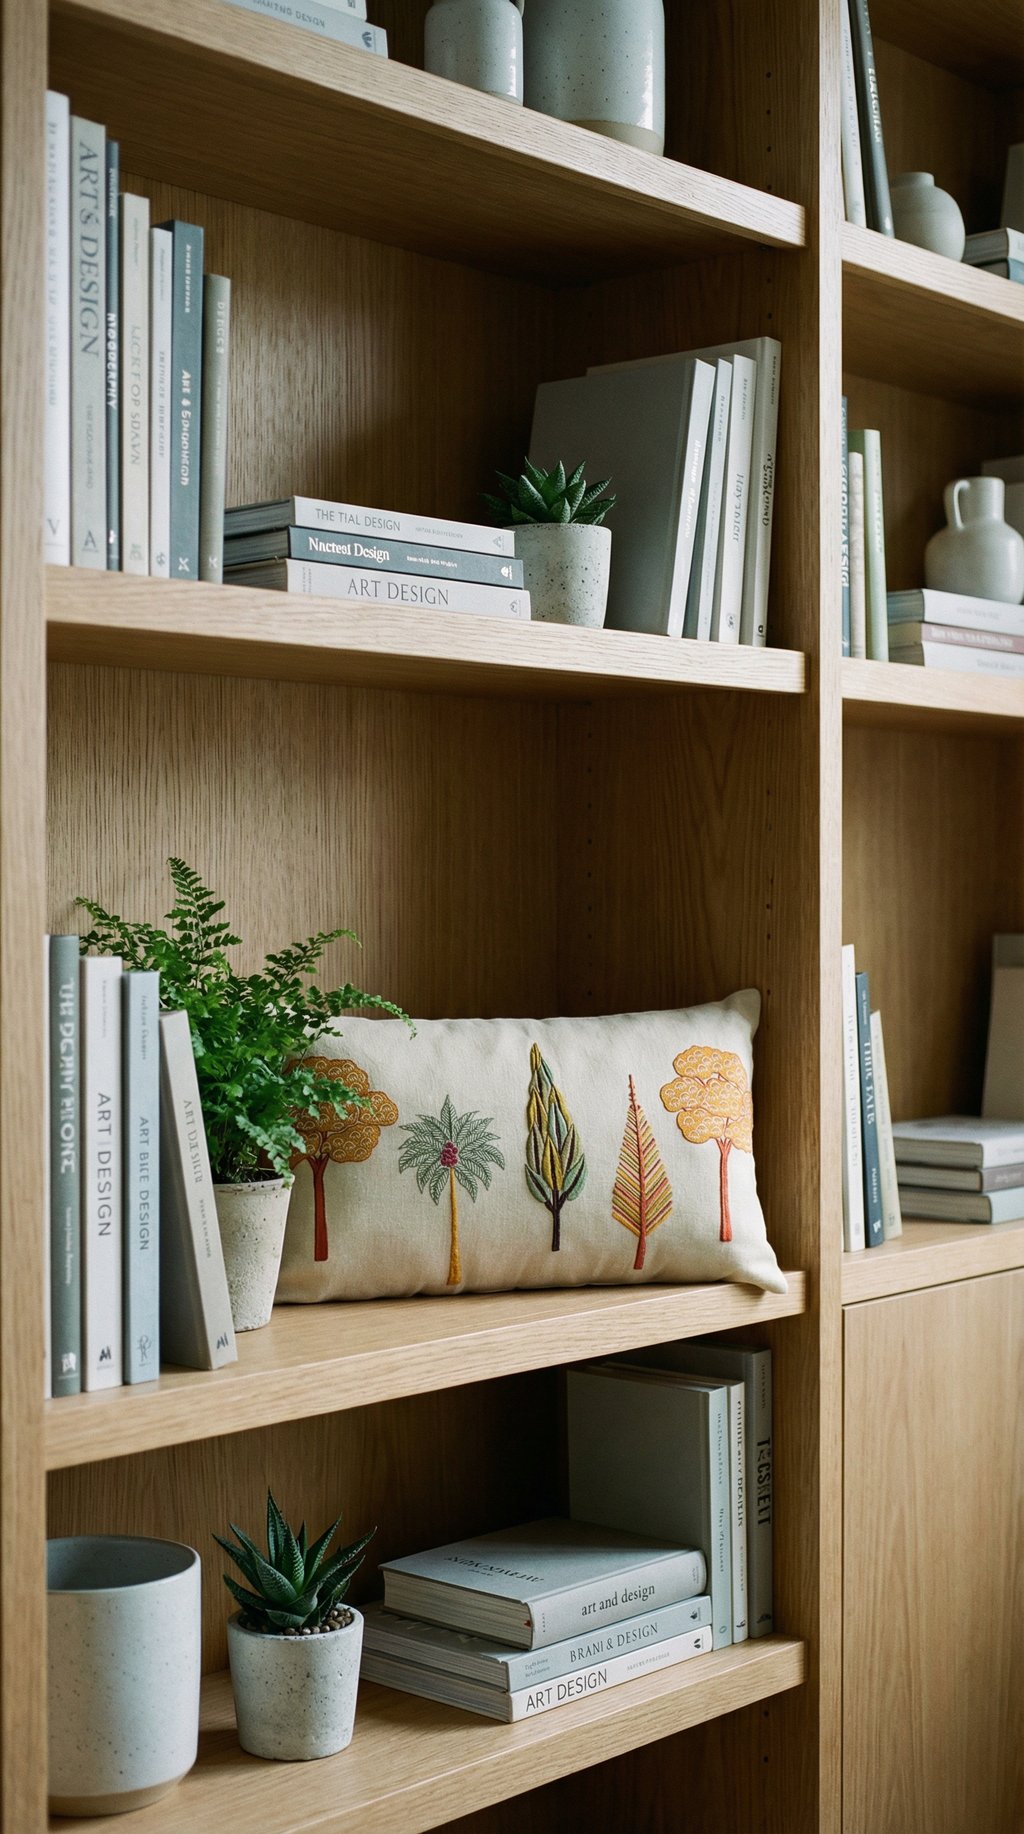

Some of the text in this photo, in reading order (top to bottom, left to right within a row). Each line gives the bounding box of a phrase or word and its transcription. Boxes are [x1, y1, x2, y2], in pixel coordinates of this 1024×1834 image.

[79, 235, 99, 357] DESIGN
[315, 507, 401, 532] THE TIAL DESIGN
[347, 577, 449, 606] ART DESIGN
[138, 1116, 150, 1146] ART
[97, 1092, 112, 1237] ART DESIGN
[138, 1190, 151, 1252] DESIGN
[581, 1585, 655, 1617] art and design
[606, 1637, 615, 1651] &
[617, 1622, 659, 1648] DESIGN
[526, 1668, 608, 1713] ART DESIGN
